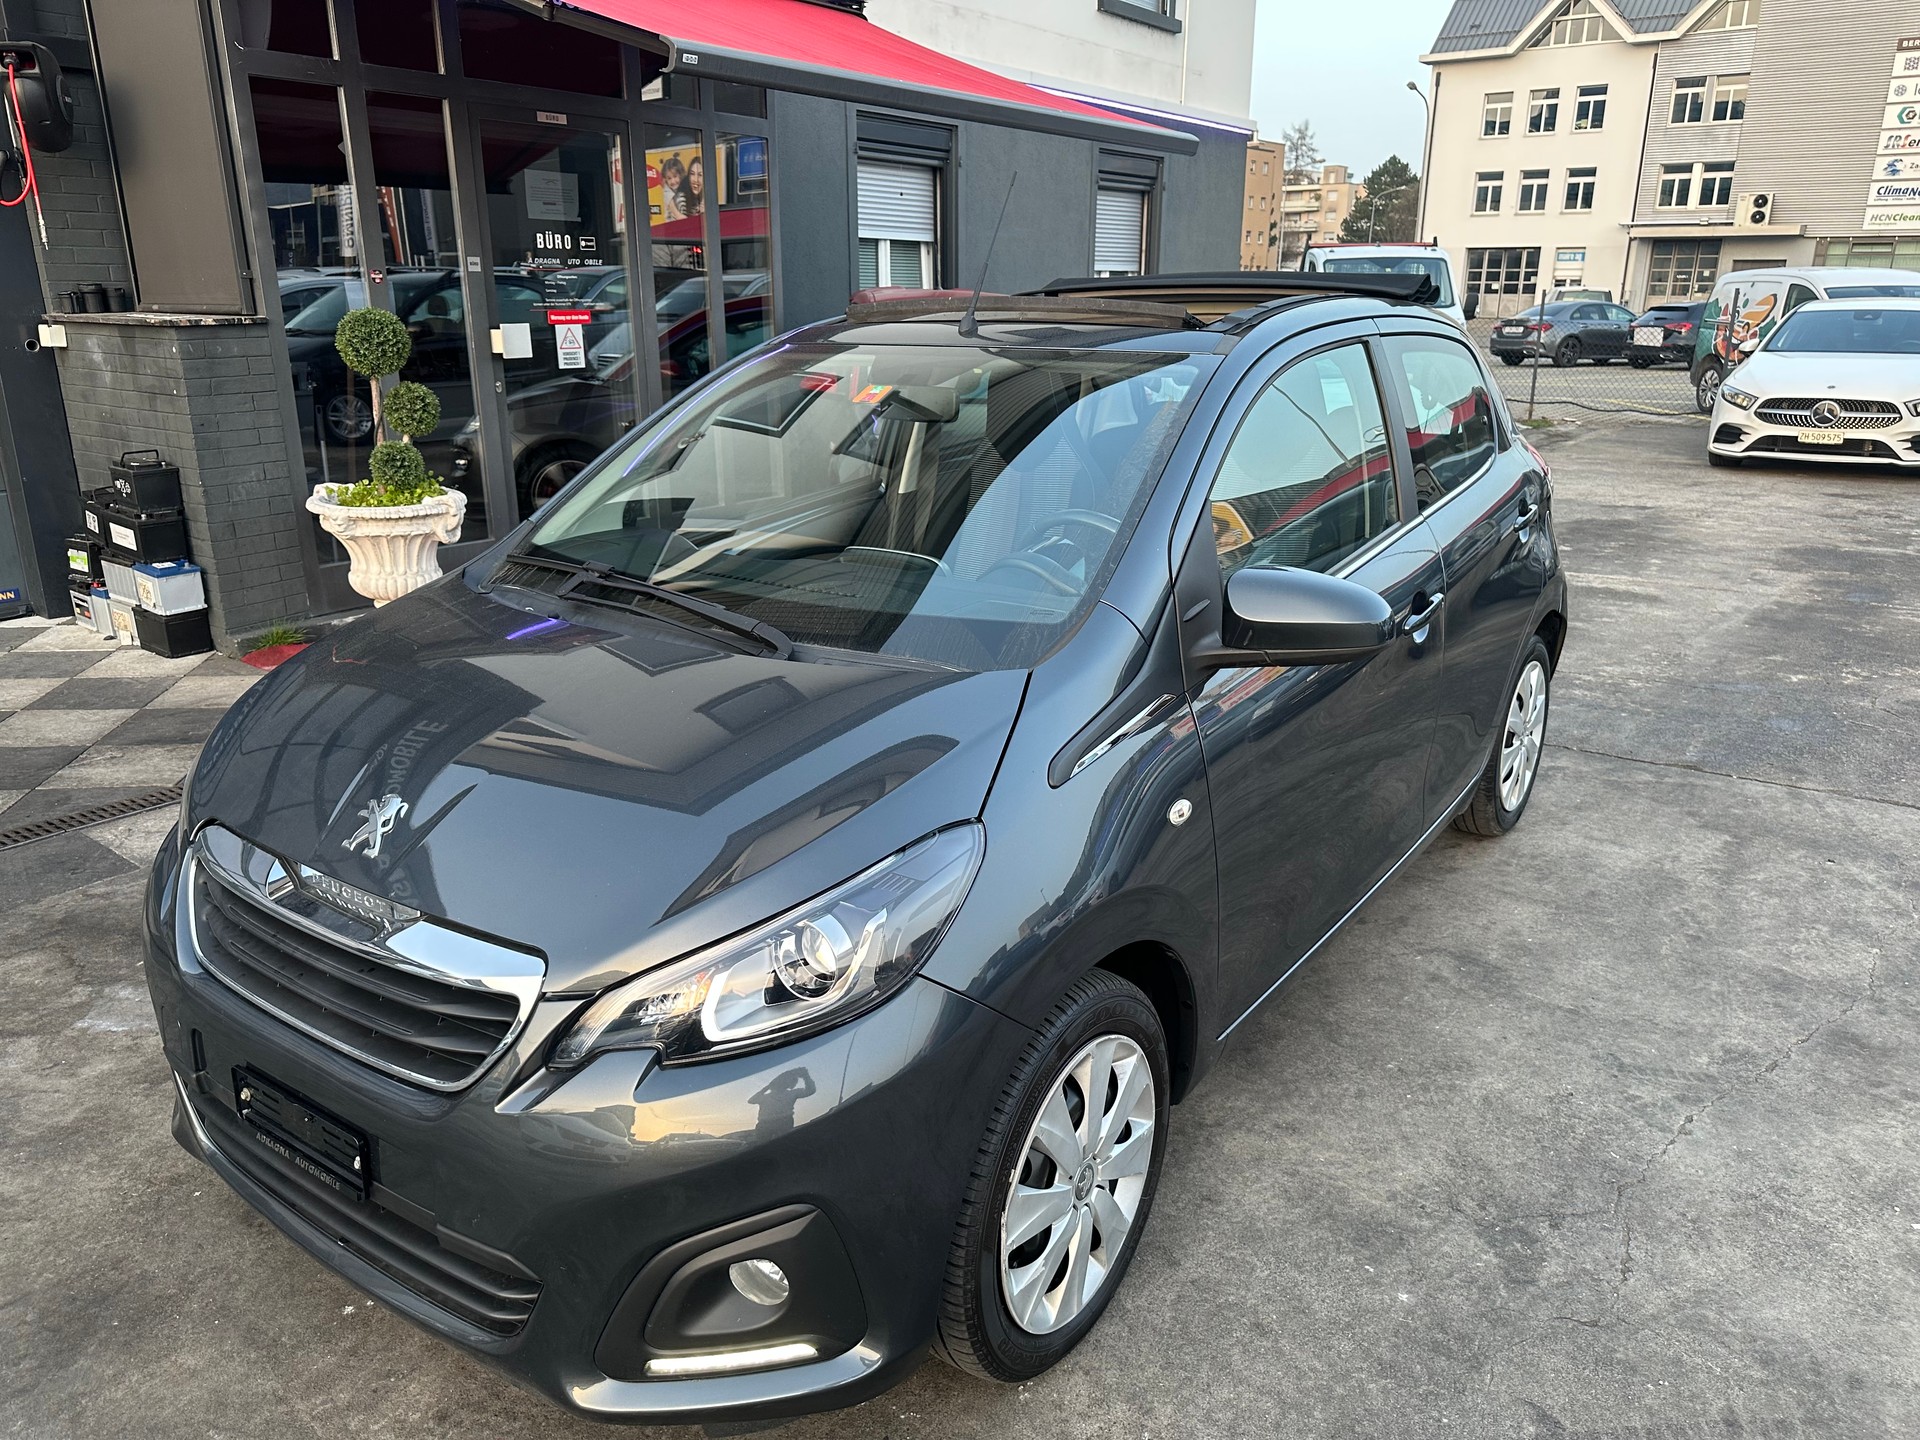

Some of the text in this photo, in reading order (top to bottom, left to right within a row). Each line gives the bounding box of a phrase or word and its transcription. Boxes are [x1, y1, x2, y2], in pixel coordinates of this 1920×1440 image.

[536, 230, 572, 250] BÜRO
[1800, 432, 1810, 440] ZH
[311, 872, 387, 912] PEUGEOT
[294, 1156, 341, 1191] AUTOMOBILE
